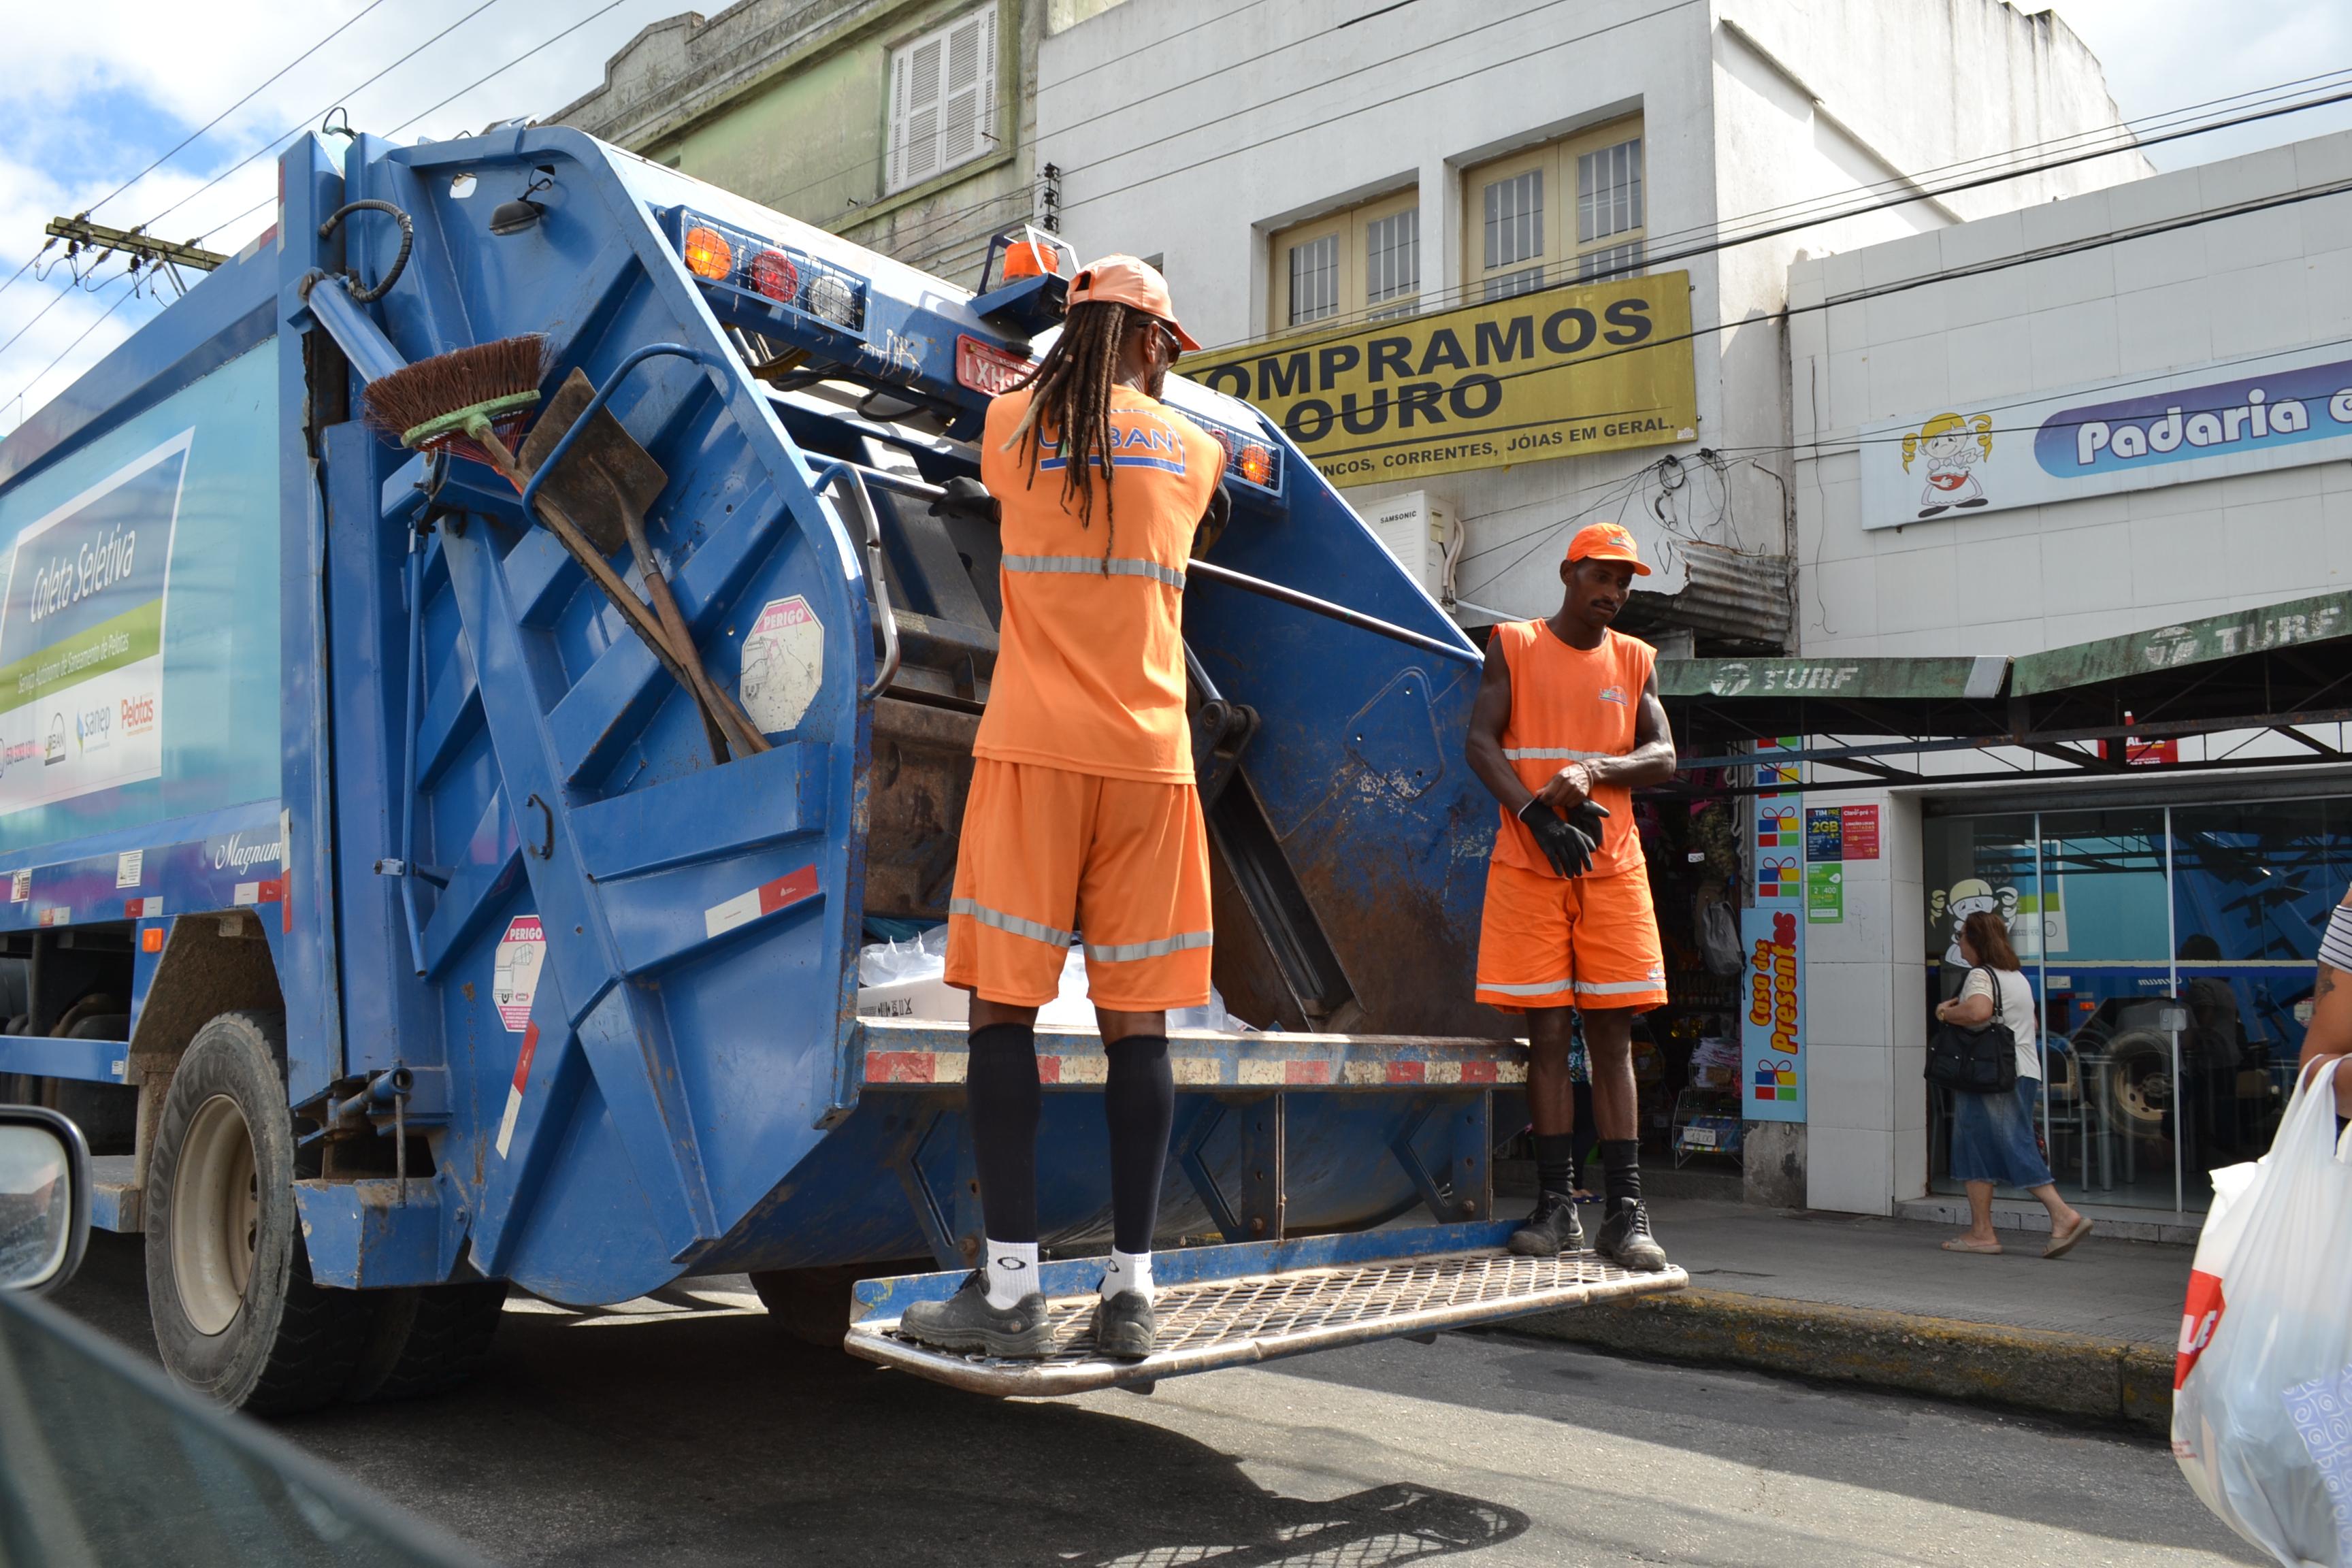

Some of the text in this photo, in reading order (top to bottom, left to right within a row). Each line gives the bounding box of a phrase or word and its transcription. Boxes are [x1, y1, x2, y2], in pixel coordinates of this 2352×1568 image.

[1185, 298, 1652, 402] OMPRAMOS
[1285, 373, 1503, 443] OURO
[1039, 425, 1173, 453] UBAN
[1383, 442, 1499, 468] CORRENTES,
[1506, 431, 1563, 451] JÓIAS
[1569, 426, 1597, 442] EM
[1603, 416, 1675, 438] GERAL.
[2076, 387, 2310, 466] Padaria
[1379, 510, 1417, 524] SAMSONIC
[30, 522, 135, 623] Coleta Seletiva
[763, 607, 804, 631] PERIGO
[2215, 606, 2342, 653] TURF
[101, 636, 108, 660] de
[109, 630, 129, 657] Pelotas
[1763, 666, 1859, 690] TURF
[85, 706, 111, 739] sanep
[121, 696, 153, 729] Pelotas
[1812, 821, 1839, 833] 2GB
[215, 832, 282, 875] Magnum
[509, 927, 543, 941] PERIGO
[1749, 938, 1772, 1027] Casa dos
